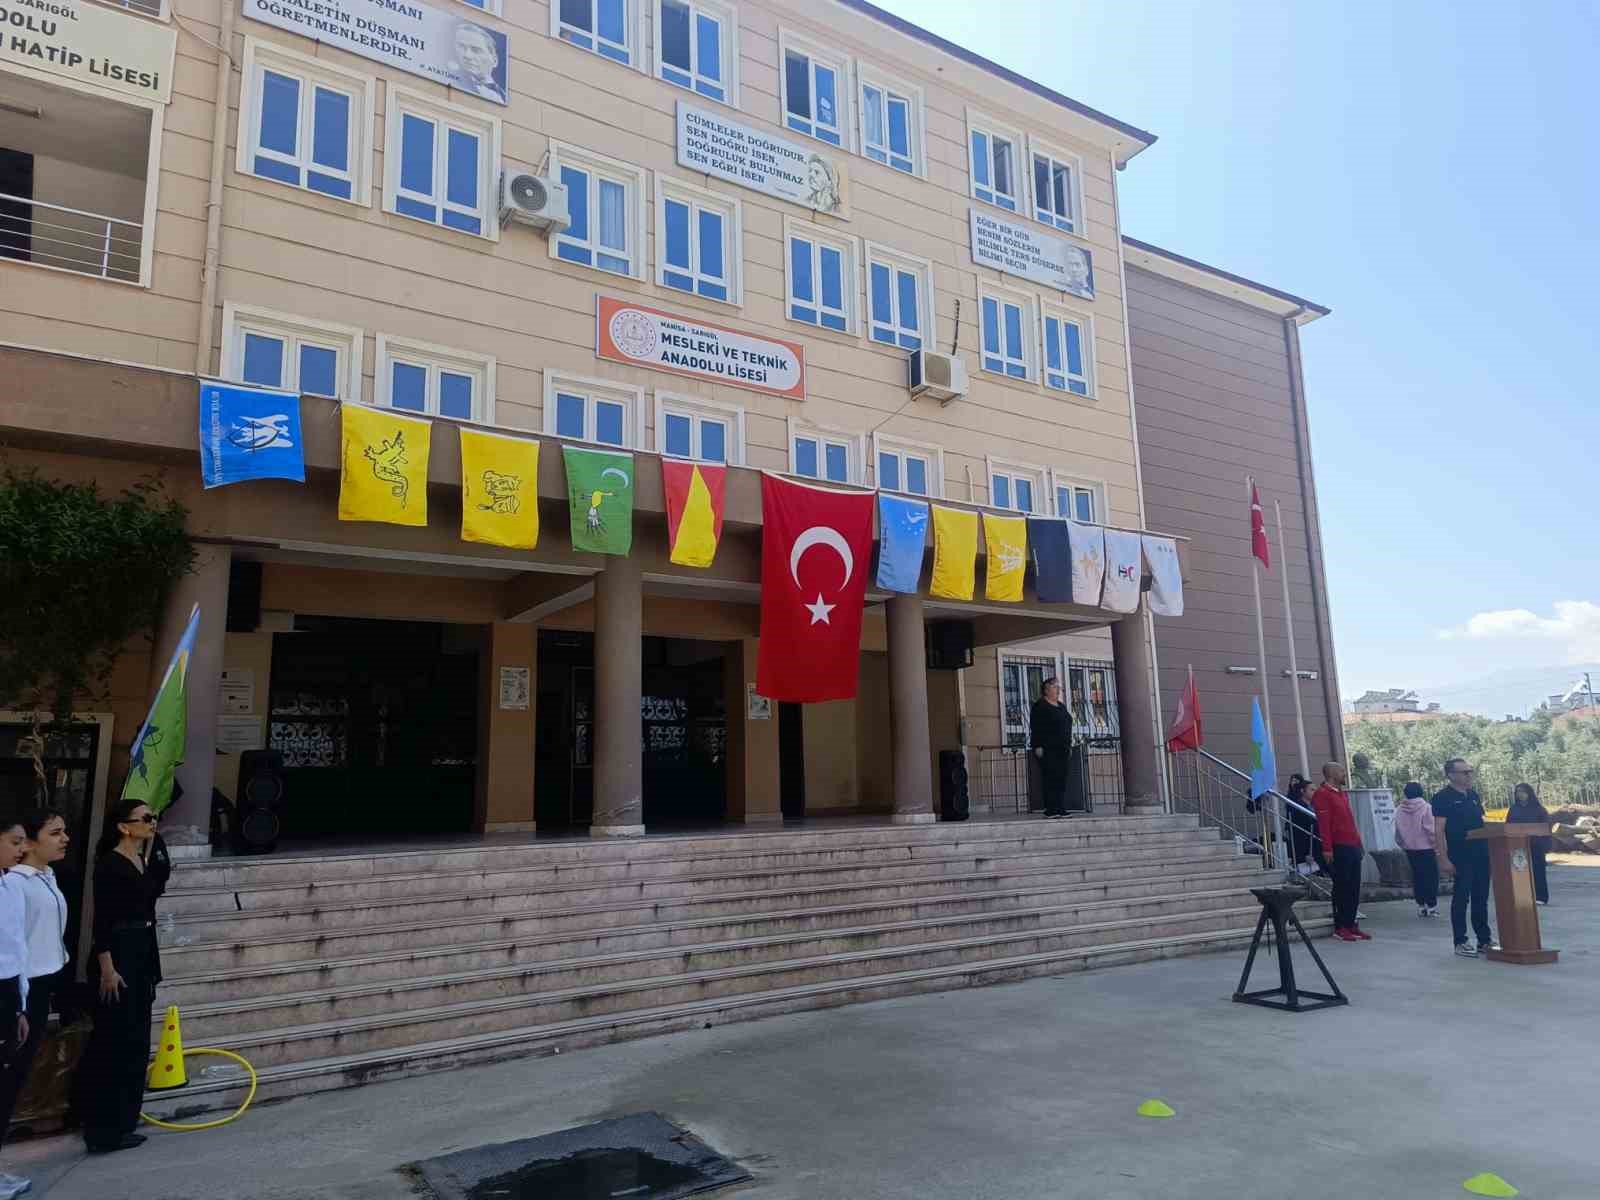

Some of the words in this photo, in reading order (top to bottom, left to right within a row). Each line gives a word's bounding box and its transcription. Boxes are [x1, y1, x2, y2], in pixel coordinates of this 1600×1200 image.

[11, 36, 83, 68] HATİP
[89, 58, 159, 90] LİSESİ
[686, 125, 708, 139] SEN
[660, 332, 720, 356] MESLEKİ
[723, 346, 738, 360] VE
[742, 351, 788, 371] TEKNİK
[660, 350, 724, 373] ANADOLU
[727, 363, 768, 383] LİSESİ
